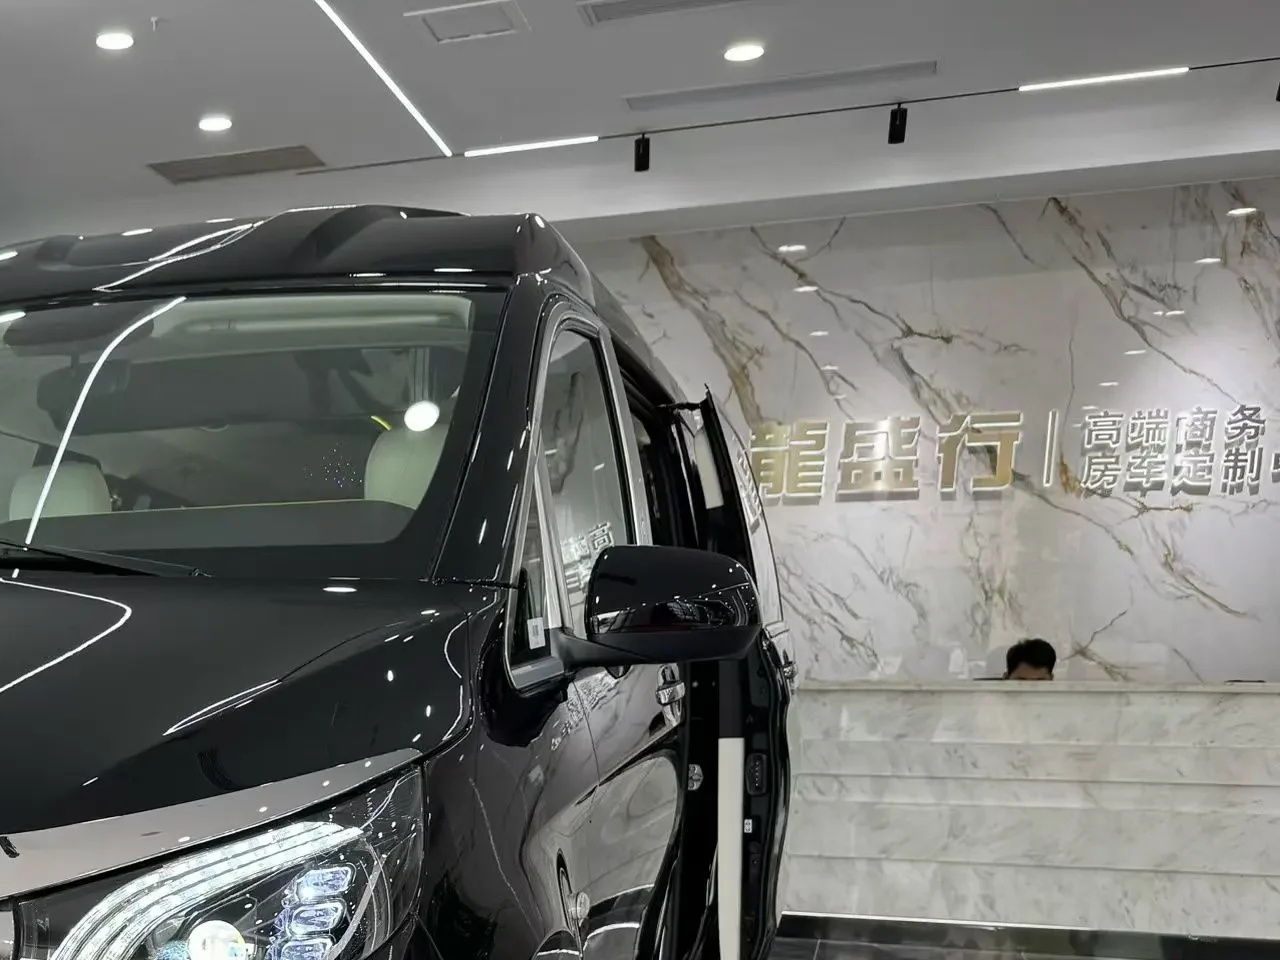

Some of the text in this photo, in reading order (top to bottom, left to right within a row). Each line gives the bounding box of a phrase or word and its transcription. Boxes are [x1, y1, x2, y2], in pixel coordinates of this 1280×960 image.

[1083, 404, 1266, 449] 高端商务
[1081, 446, 1264, 489] 房车定制
